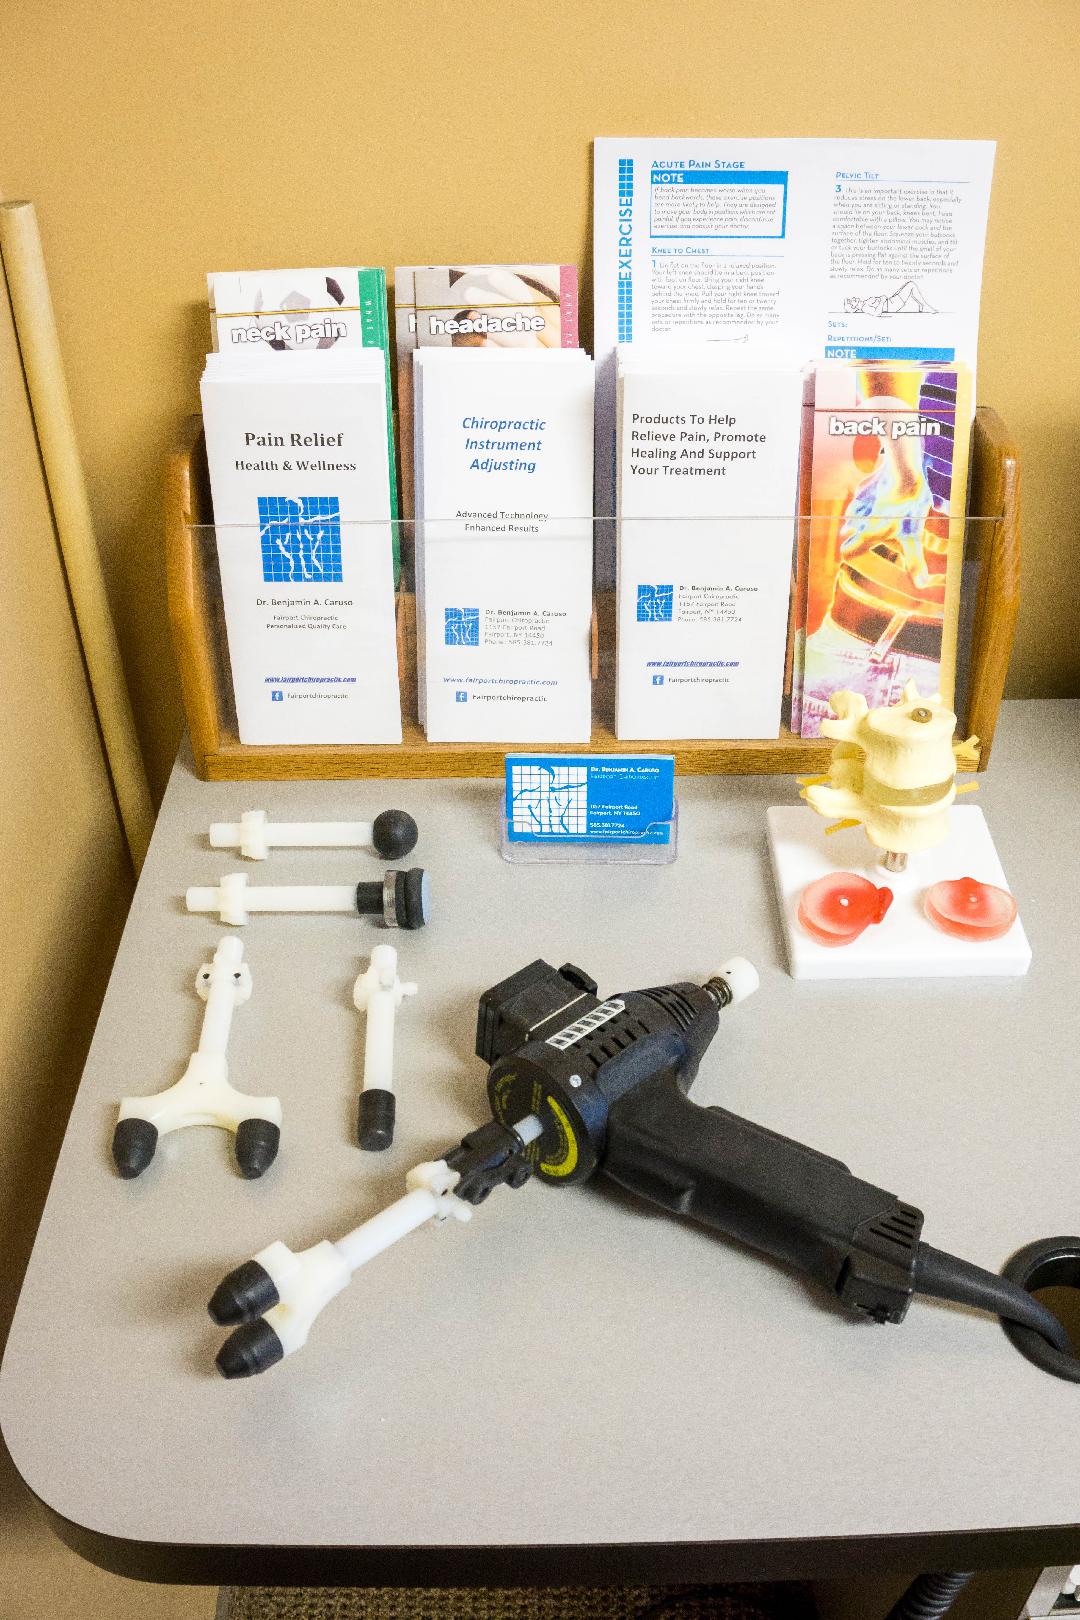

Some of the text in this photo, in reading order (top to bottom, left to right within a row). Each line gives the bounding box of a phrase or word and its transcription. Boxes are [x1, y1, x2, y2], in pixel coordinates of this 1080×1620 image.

[652, 160, 745, 169] ACUTE PAIN STAGE
[653, 173, 684, 183] NOTE
[835, 184, 842, 192] 3
[618, 197, 632, 280] EXERCISE
[232, 318, 348, 343] neck pain
[429, 313, 545, 335] headache
[827, 350, 856, 358] NOTE
[462, 416, 546, 432] Chiropractic
[632, 414, 736, 427] Products To Help
[828, 416, 941, 440] back pain
[244, 432, 344, 446] Pain Relief
[631, 430, 766, 443] Relieve Pain, Promote
[465, 438, 543, 451] Instrument
[631, 448, 756, 461] Healing And Support
[235, 460, 357, 471] Health & Wellness
[470, 458, 536, 473] Adjusting
[630, 465, 726, 476] Your Treatment
[500, 512, 549, 522] Technology
[465, 524, 506, 532] Enhanced
[272, 599, 310, 607] Benjamin
